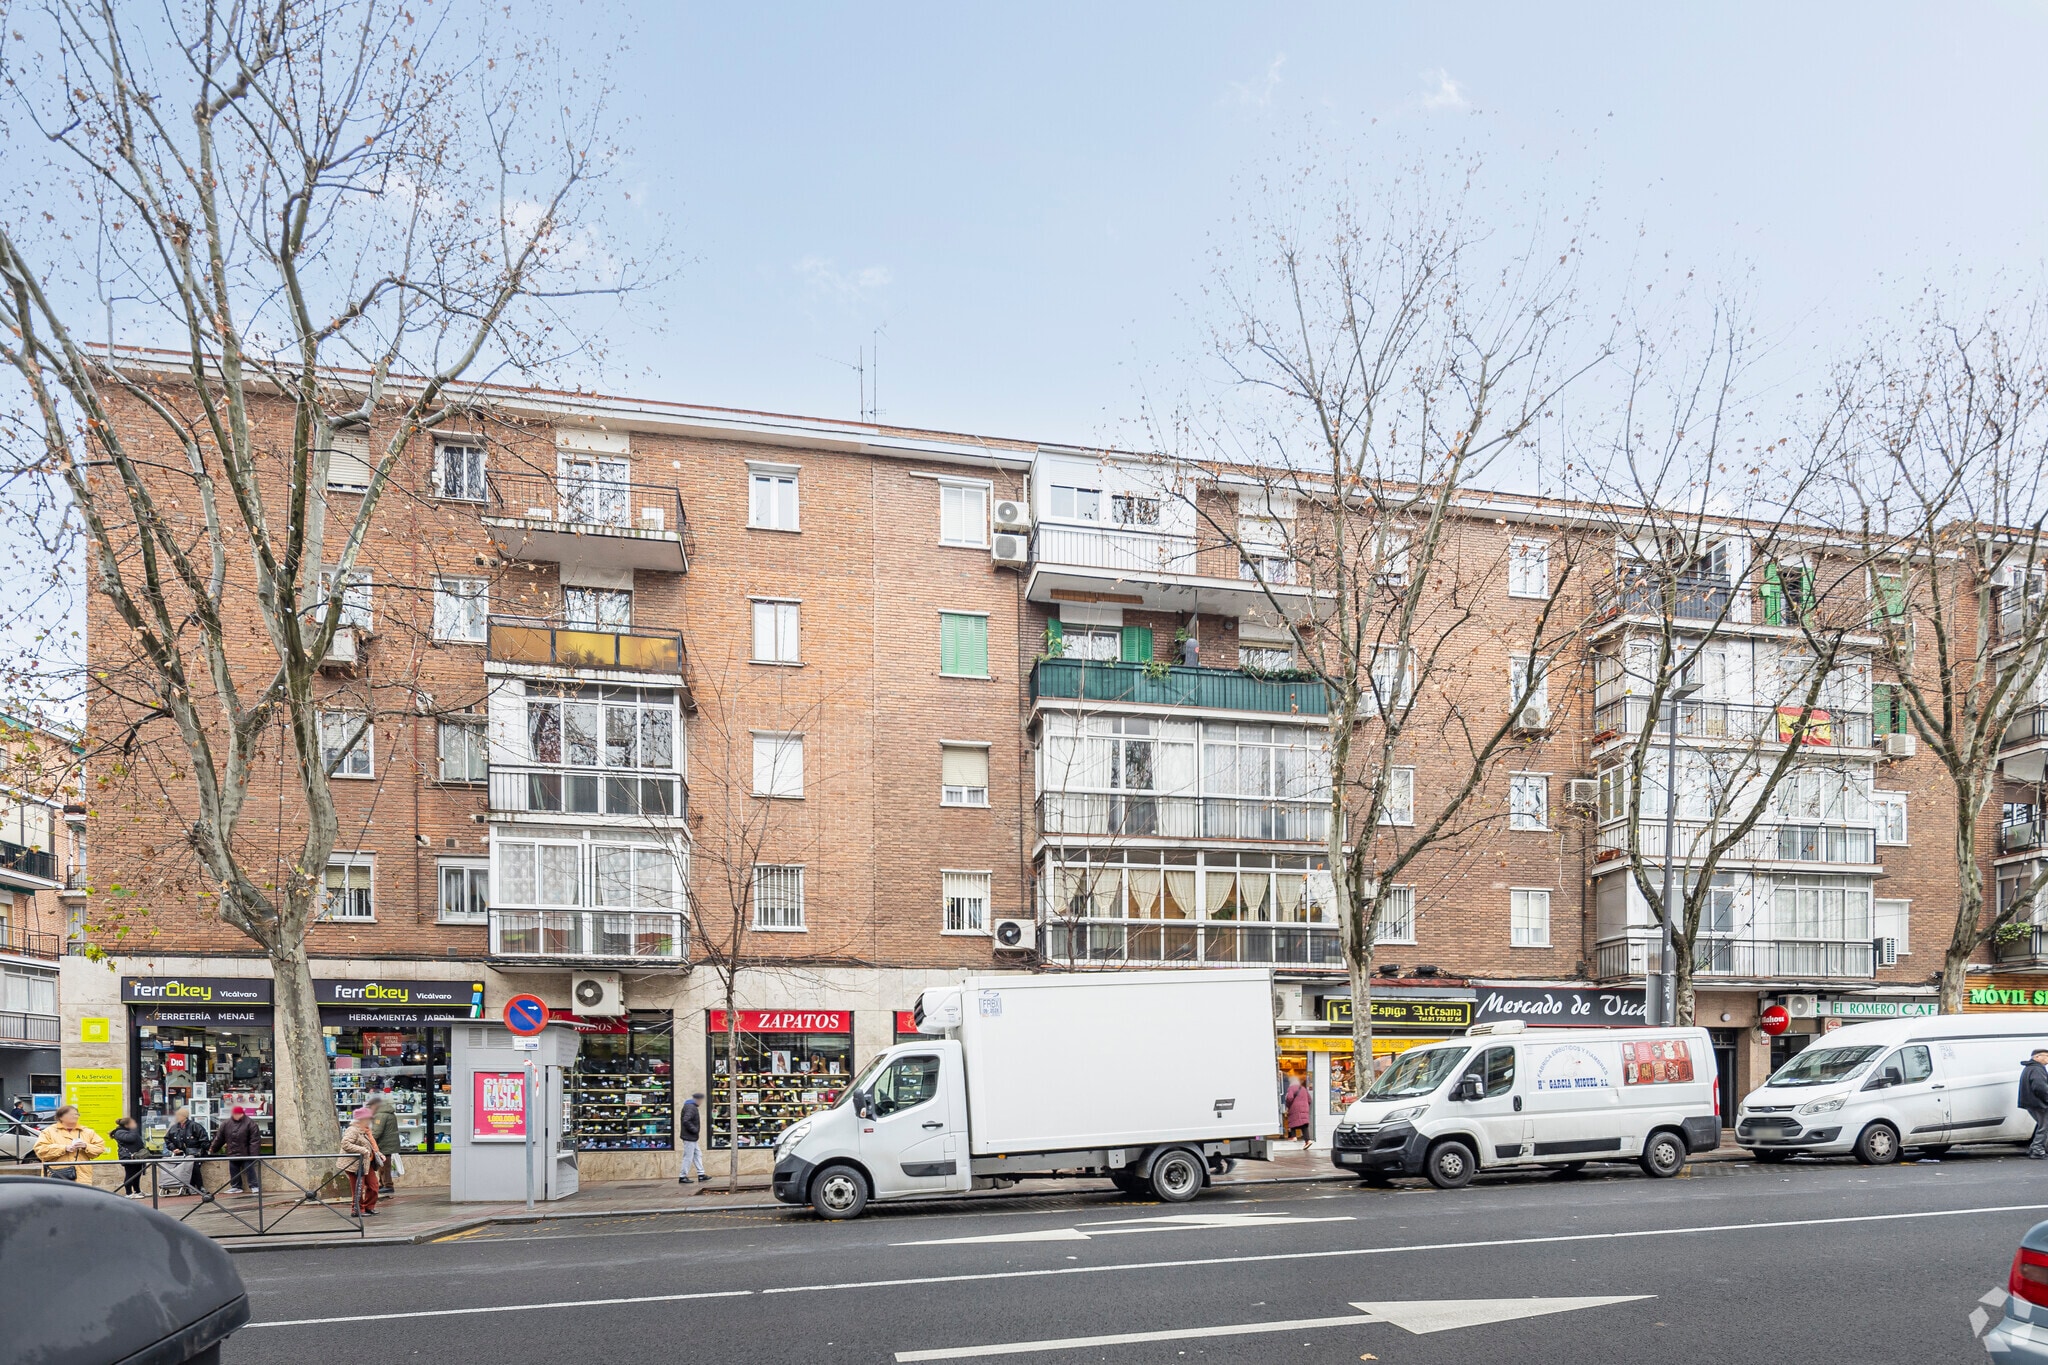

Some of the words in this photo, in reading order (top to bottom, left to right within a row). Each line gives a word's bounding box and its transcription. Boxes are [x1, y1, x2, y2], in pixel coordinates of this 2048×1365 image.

[134, 981, 212, 1001] ferrOkey
[220, 990, 257, 998] Vicálvaro
[335, 983, 408, 1002] ferrOkey
[416, 992, 451, 1000] Vicálvaro
[1971, 984, 2028, 1005] MÓVIL
[1370, 1004, 1407, 1017] Espiga
[1412, 1004, 1462, 1016] Artesana
[1476, 991, 1563, 1018] Mercado
[1571, 994, 1591, 1015] de
[1834, 1002, 1845, 1014] EL
[1850, 1002, 1896, 1015] ROMERO
[1901, 1003, 1935, 1015] CAF
[156, 1011, 211, 1021] FERRETERÍA
[218, 1012, 255, 1021] MENAJE
[348, 1013, 417, 1022] HERRAMIENTAS
[758, 1013, 840, 1029] ZAPATOS
[483, 1078, 523, 1086] QUIEN
[1549, 1079, 1572, 1089] GARCIA
[1574, 1077, 1598, 1088] MIGUEL
[483, 1084, 523, 1108] RASCA
